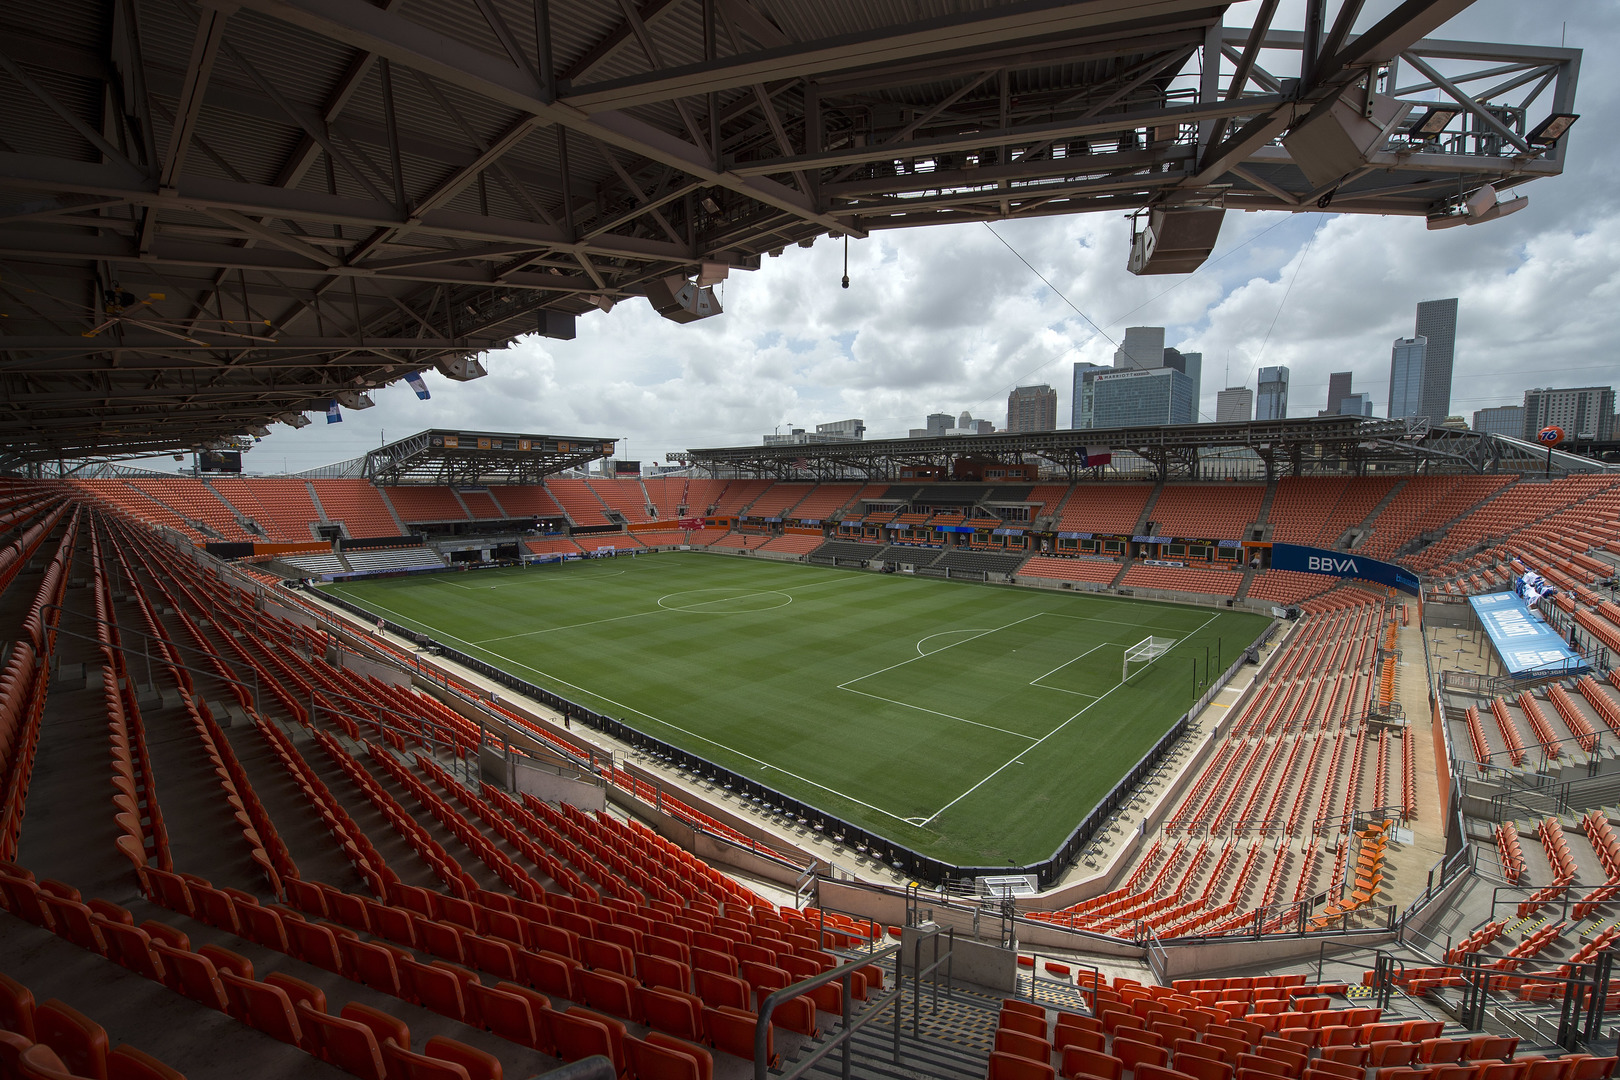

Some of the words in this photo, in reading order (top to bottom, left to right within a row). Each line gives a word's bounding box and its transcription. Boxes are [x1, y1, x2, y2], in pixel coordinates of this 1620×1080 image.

[1104, 372, 1133, 380] MARRIOTT
[1541, 430, 1557, 441] 76
[1308, 556, 1359, 573] BBVA
